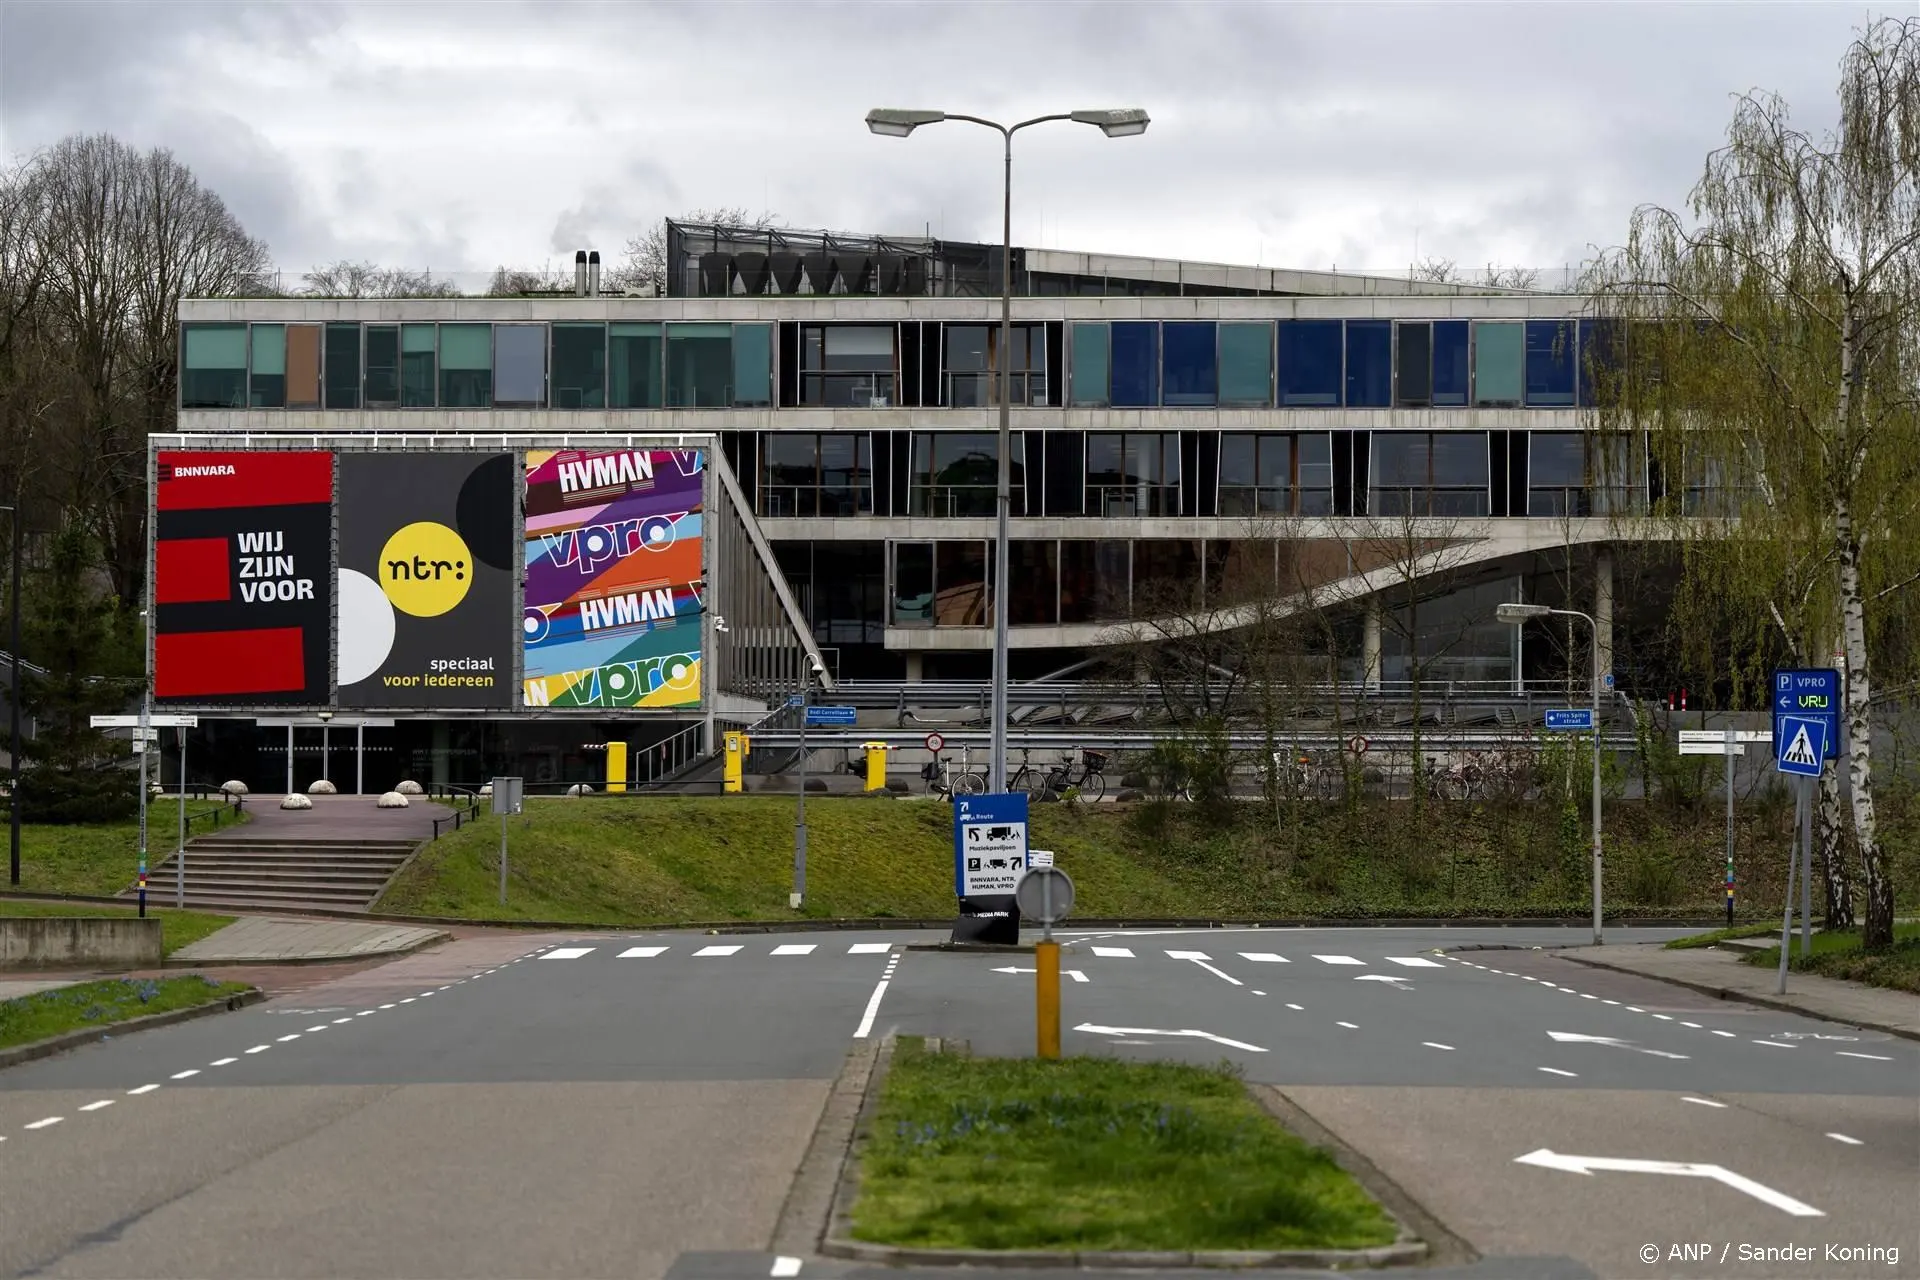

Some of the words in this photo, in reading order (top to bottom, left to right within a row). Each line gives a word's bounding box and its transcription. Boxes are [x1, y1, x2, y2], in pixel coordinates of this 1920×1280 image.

[174, 465, 236, 477] BNNVARA
[237, 531, 284, 554] WIJ
[540, 511, 689, 574] vpro
[239, 555, 294, 578] ZIJN
[239, 579, 315, 603] VOOR
[430, 657, 495, 672] speciaal
[383, 676, 420, 687] voor
[424, 674, 494, 687] iedereen
[1780, 676, 1789, 688] P
[1797, 677, 1826, 687] VPRO
